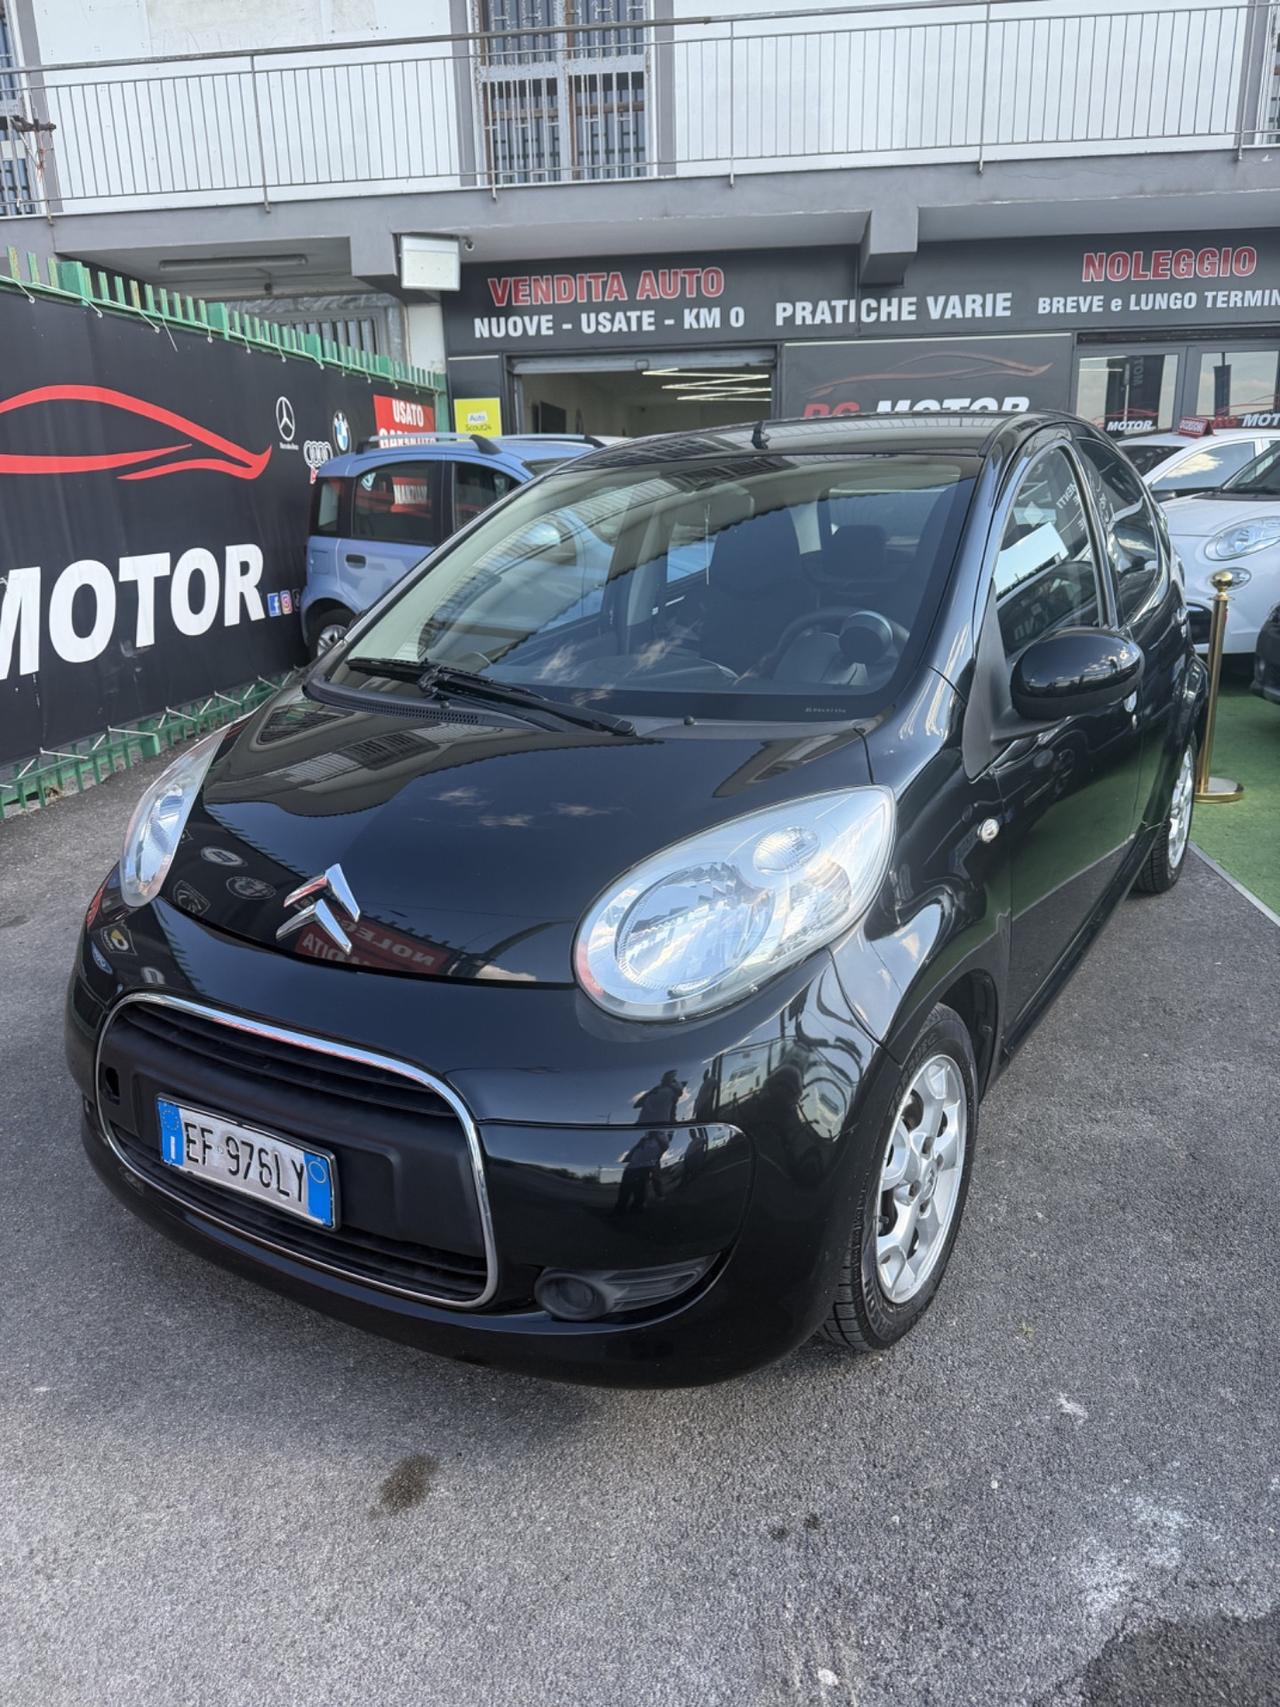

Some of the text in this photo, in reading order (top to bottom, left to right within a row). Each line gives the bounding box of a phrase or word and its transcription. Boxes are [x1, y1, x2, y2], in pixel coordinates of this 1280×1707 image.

[1082, 246, 1257, 282] NOLEGGIO
[488, 267, 724, 307] VENDITA AUTO
[1037, 295, 1104, 314] BREVE
[1110, 299, 1122, 312] e
[1129, 292, 1197, 311] LUNGO
[474, 314, 554, 338] NUOVE
[581, 310, 656, 333] USATE
[683, 307, 721, 329] KM
[776, 292, 1012, 326] PRATICHE VARIE
[392, 399, 424, 427] USATO
[1106, 420, 1153, 431] MOTOR
[184, 1121, 304, 1202] EF 976LY
